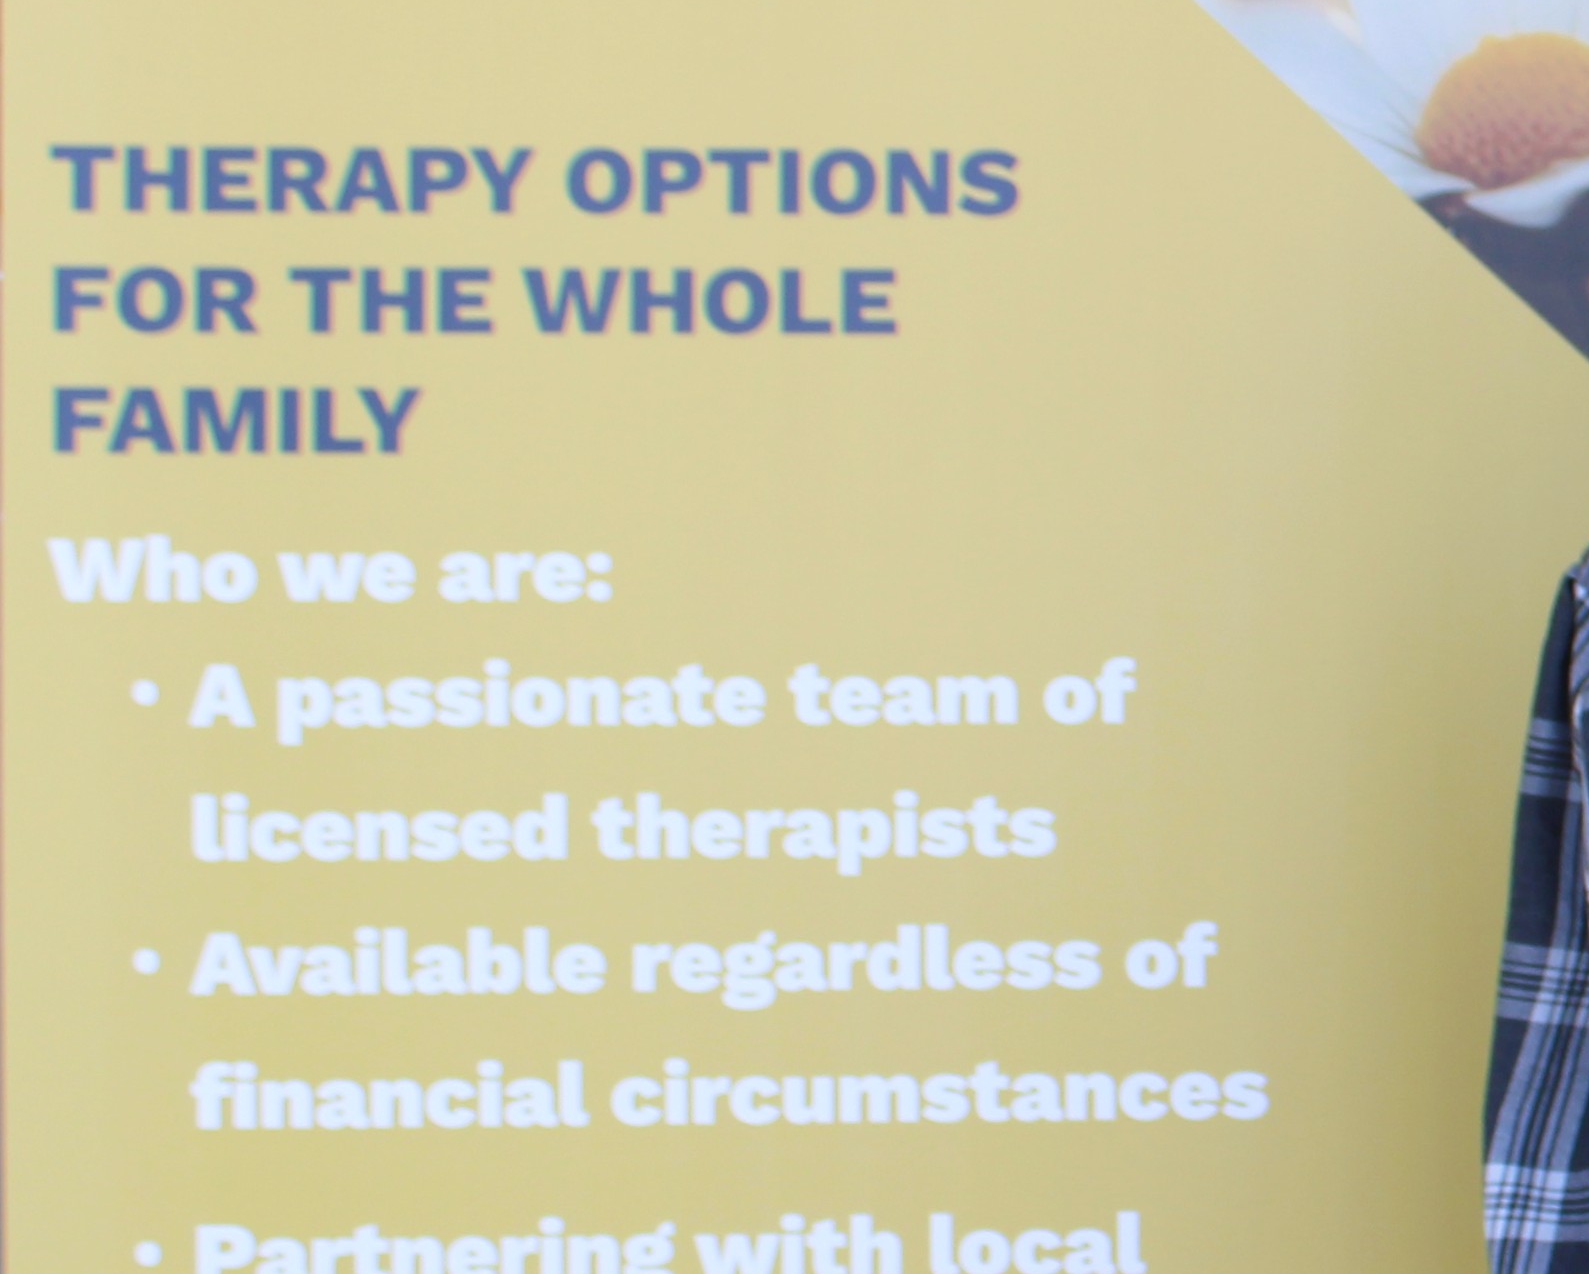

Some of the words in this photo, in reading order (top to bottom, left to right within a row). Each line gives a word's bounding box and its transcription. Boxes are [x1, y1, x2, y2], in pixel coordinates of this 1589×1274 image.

[49, 145, 531, 213] THERAPY
[565, 147, 1018, 216] OPTIONS
[53, 266, 255, 333] FOR
[287, 267, 491, 333] THE
[521, 267, 896, 335] WHOLE
[53, 387, 418, 454] FAMILY
[47, 533, 259, 603] Who
[277, 551, 417, 603] we
[439, 551, 613, 603] are:
[188, 663, 256, 728] A
[277, 657, 767, 747] passionate
[787, 663, 1019, 726] team
[1043, 656, 1138, 725] of
[191, 792, 569, 863] licensed
[591, 789, 1058, 877] therapists
[189, 925, 608, 996] Available
[632, 923, 1103, 1011] regardless
[1125, 920, 1219, 990] of
[189, 1058, 591, 1131] financial
[610, 1056, 1270, 1127] circumstances
